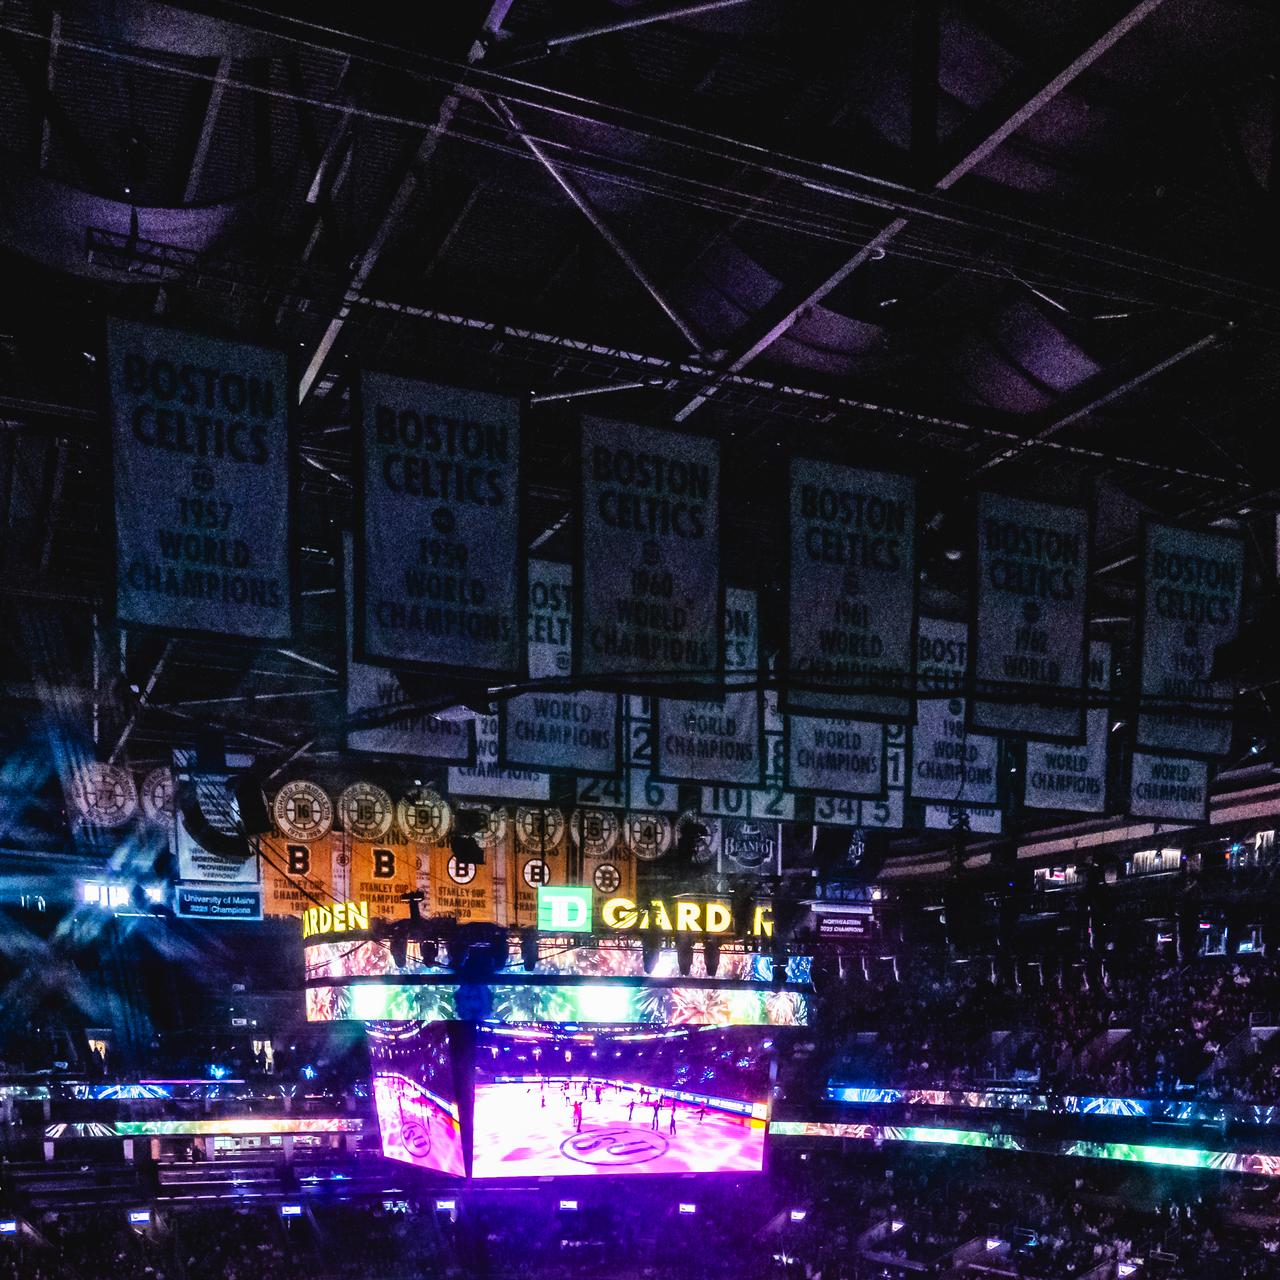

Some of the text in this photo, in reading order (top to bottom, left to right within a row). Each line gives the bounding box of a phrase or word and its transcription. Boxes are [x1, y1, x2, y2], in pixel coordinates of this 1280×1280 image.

[124, 353, 274, 418] BOSTON
[132, 404, 267, 465] CELTICS
[376, 405, 509, 463] BOSTON
[383, 454, 503, 506] CELTICS
[593, 445, 709, 499] BOSTON
[598, 491, 704, 539] CELTICS
[801, 484, 905, 533] BOSTON
[160, 528, 250, 569] WORLD
[805, 527, 899, 572] CELTICS
[987, 520, 1079, 561] BOSTON
[126, 561, 281, 607] CHAMPIONS
[533, 698, 591, 723] WORLD
[515, 720, 610, 750] CHAMPIONS
[684, 714, 736, 738] WORLD
[665, 735, 754, 762] CHAMPIONS
[814, 729, 862, 750] WORLD
[933, 741, 978, 762] WORLD
[797, 749, 878, 774] CHAMPIONS
[917, 761, 993, 785] CHAMPIONS
[1045, 752, 1088, 773] WORLD
[1151, 763, 1191, 781] WORLD
[1031, 772, 1100, 795] CHAMPIONS
[1136, 781, 1201, 801] CHAMPIONS
[297, 803, 309, 819] 16
[419, 811, 428, 824] 9
[589, 820, 600, 836] 5
[642, 825, 653, 839] 4
[725, 837, 777, 857] BEANPOT
[287, 844, 311, 877] B
[373, 848, 396, 878] B
[184, 894, 255, 905] University of Maine
[360, 882, 392, 893] STANLEY
[438, 887, 470, 897] STANLEY
[211, 905, 251, 914] Champions
[438, 898, 486, 909] CHAMPIONS
[542, 895, 775, 937] TD GARDN
[303, 901, 369, 939] ARDEN
